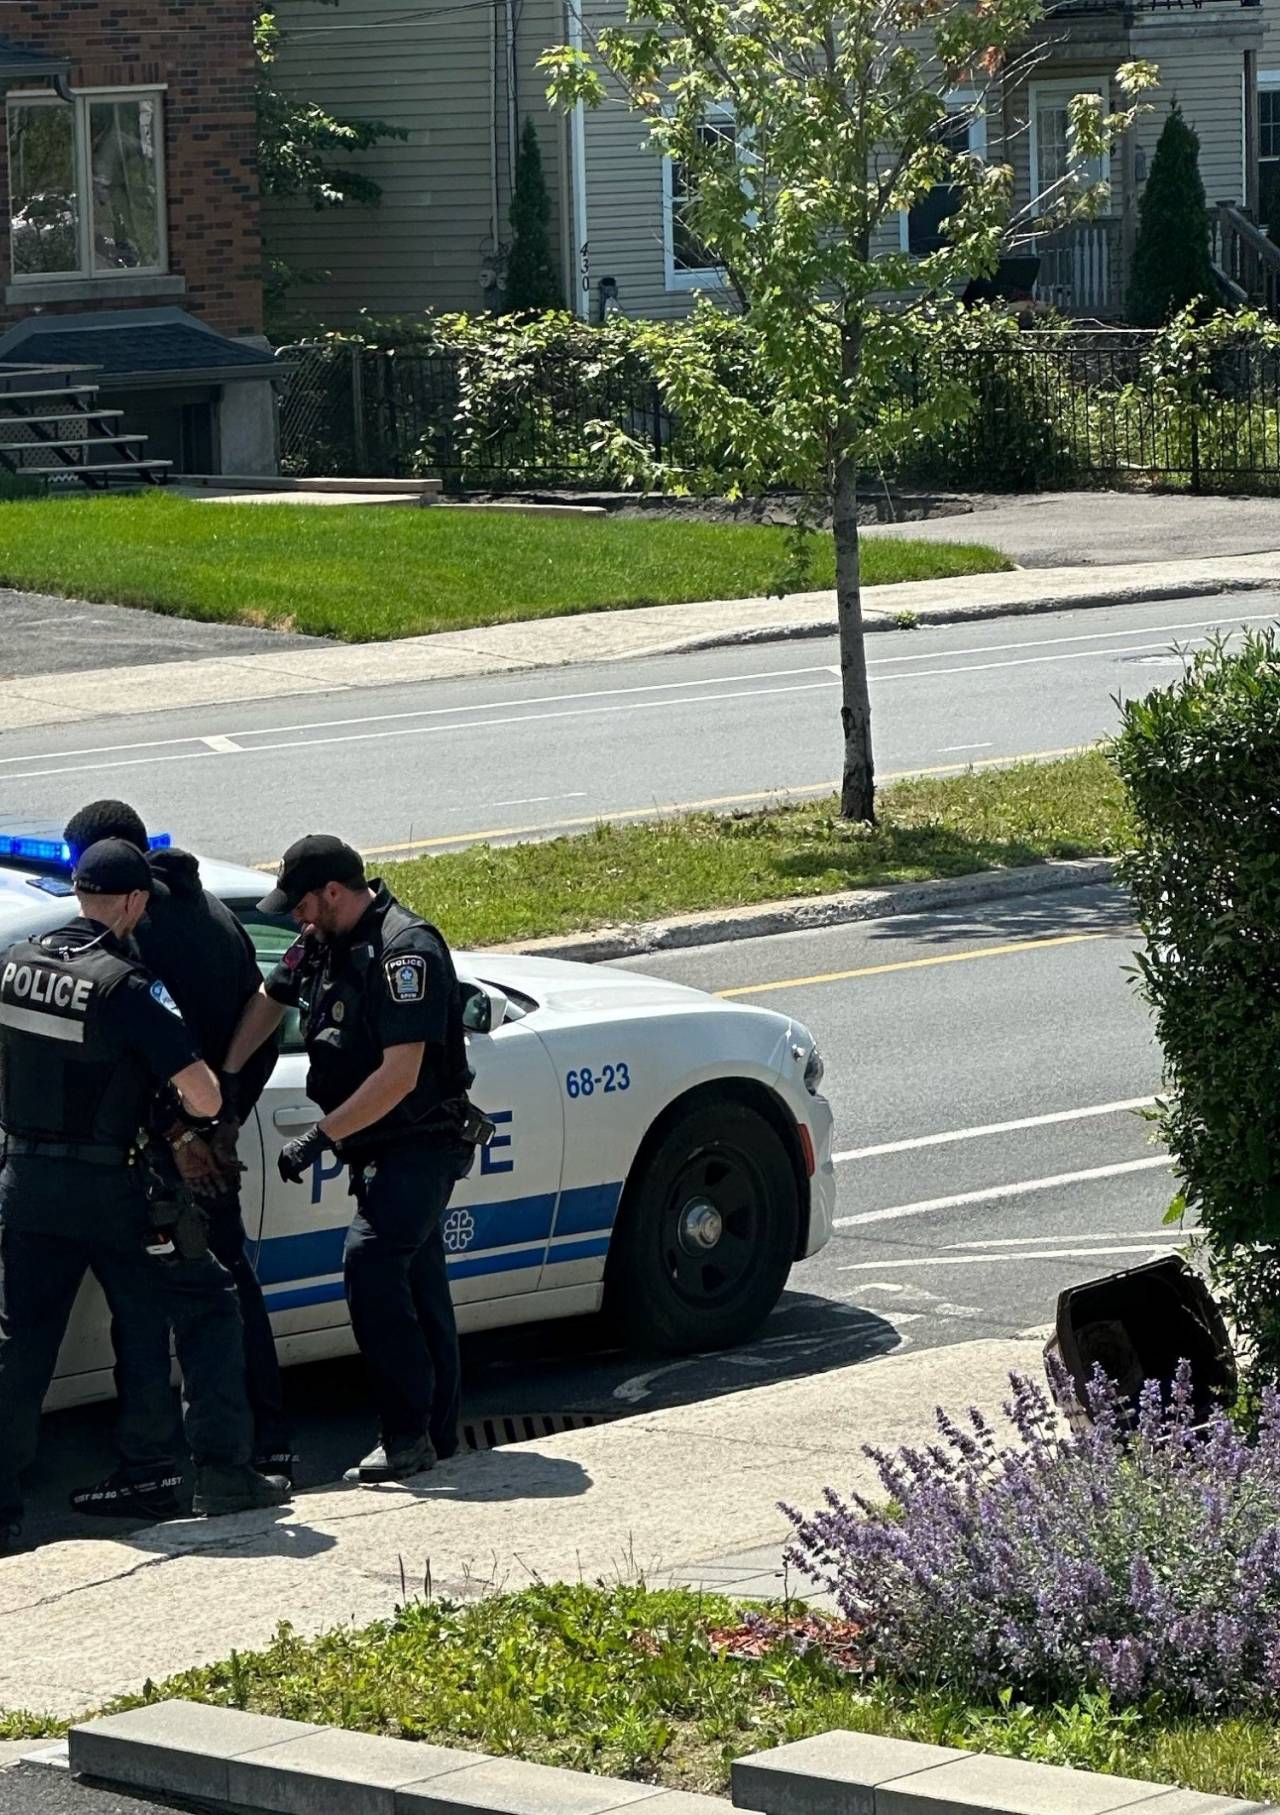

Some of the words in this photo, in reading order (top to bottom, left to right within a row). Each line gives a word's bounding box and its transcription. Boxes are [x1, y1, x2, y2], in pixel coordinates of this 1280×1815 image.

[580, 240, 590, 292] 430
[390, 959, 423, 969] POLICE
[1, 962, 93, 1012] POLICE
[565, 1061, 631, 1099] 68-23
[160, 1476, 183, 1488] JUST
